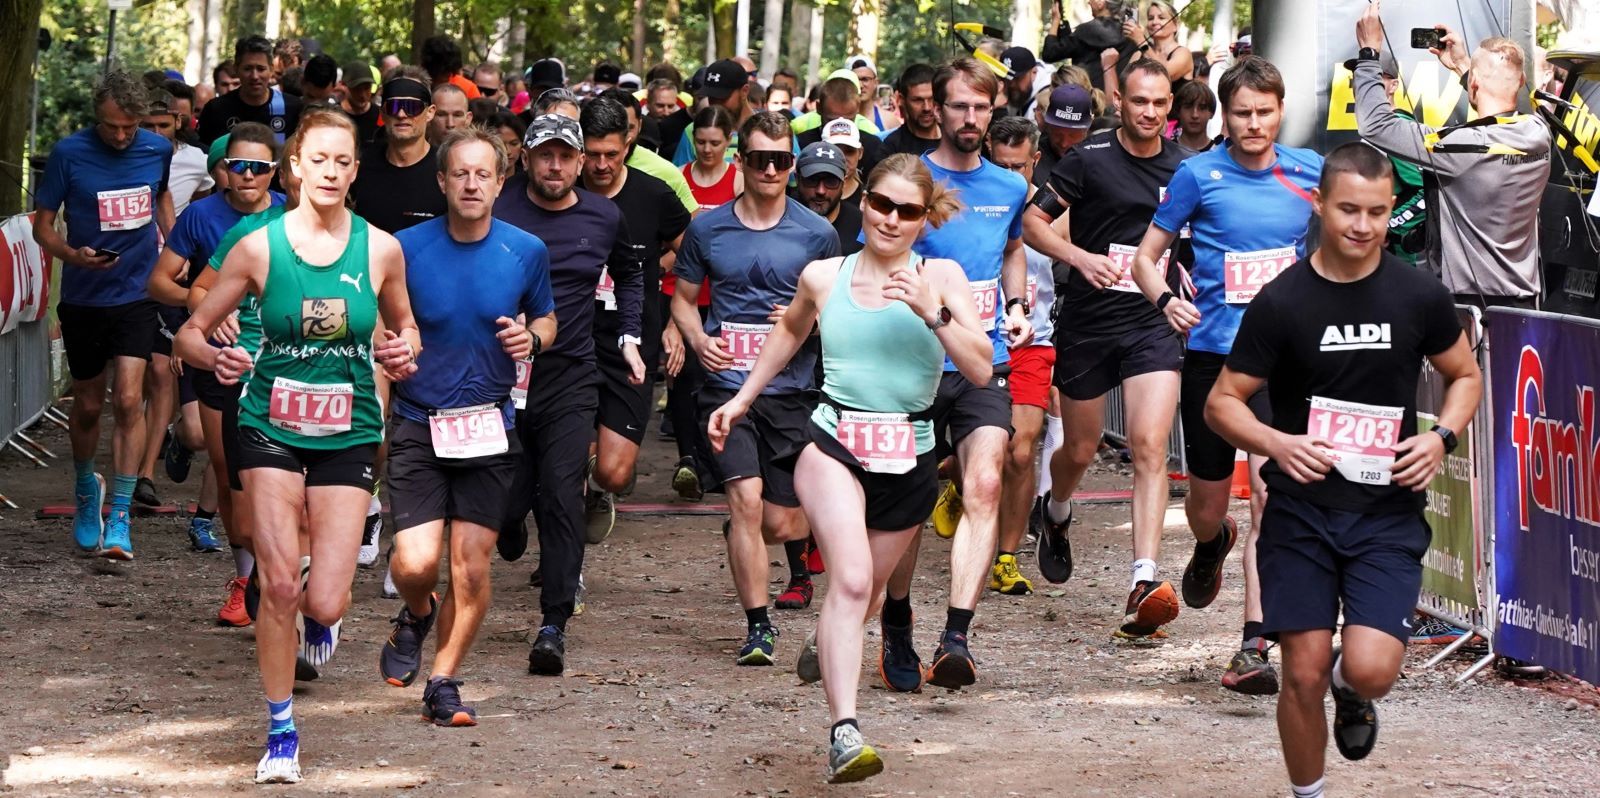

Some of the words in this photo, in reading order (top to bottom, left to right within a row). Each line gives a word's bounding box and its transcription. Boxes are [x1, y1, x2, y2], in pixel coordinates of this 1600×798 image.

[102, 194, 149, 217] 1152
[973, 289, 995, 315] 39
[725, 332, 767, 355] 113
[1320, 323, 1391, 345] ALDI
[277, 390, 347, 419] 1170
[1326, 402, 1382, 416] Rosengartenlauf
[436, 413, 499, 441] 1195
[849, 414, 899, 422] Rosengartenlauf
[842, 423, 911, 453] 1137
[1316, 411, 1395, 449] 1203
[1360, 471, 1382, 481] 1203
